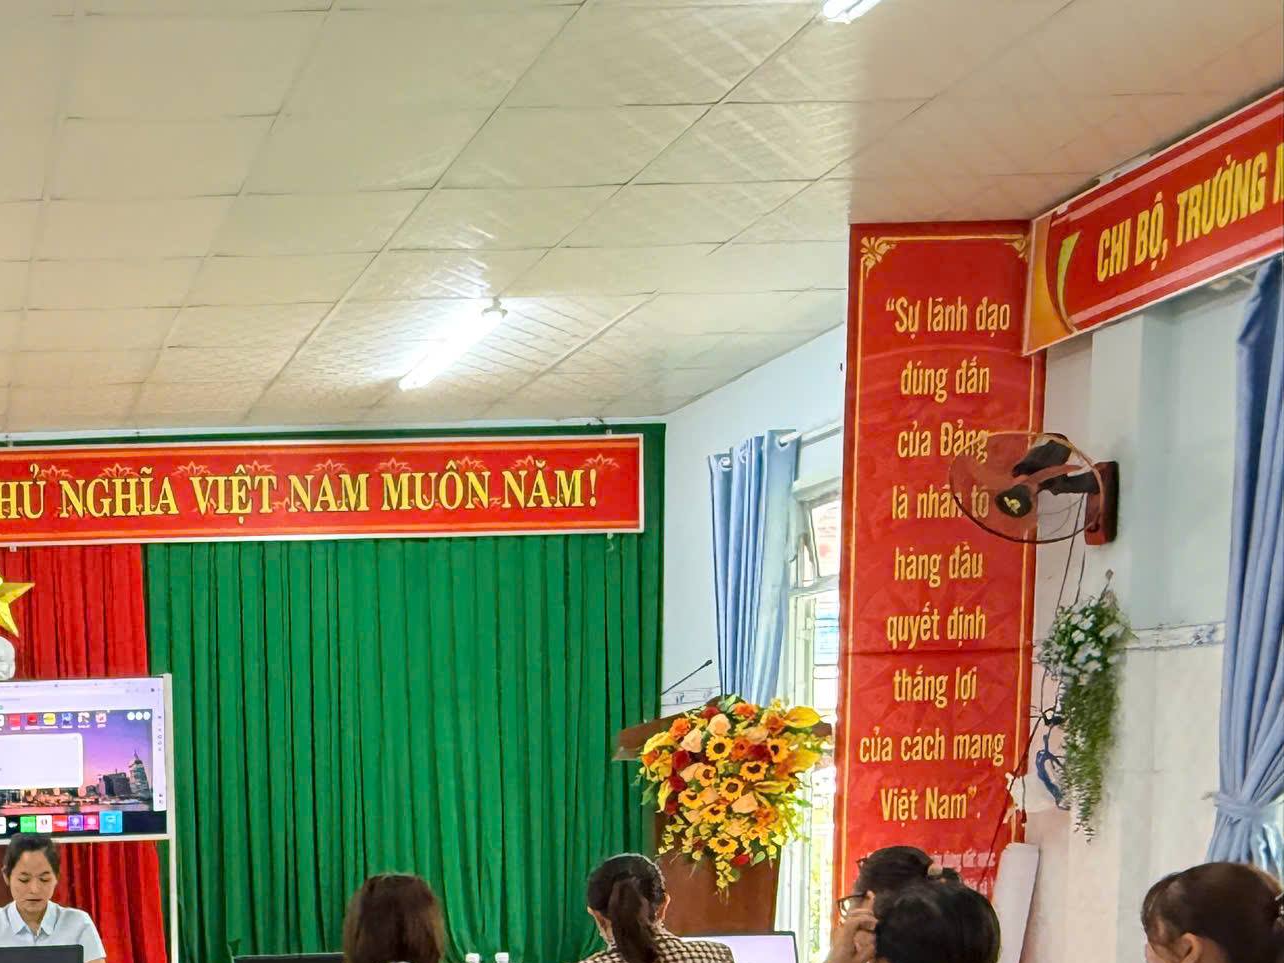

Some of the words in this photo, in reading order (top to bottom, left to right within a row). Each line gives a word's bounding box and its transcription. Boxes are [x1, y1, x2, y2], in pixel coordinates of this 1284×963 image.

[1097, 220, 1131, 282] CHI
[1134, 191, 1169, 272] BỘ,
[1175, 151, 1268, 248] TRƯỜNG
[927, 296, 968, 332] lãnh
[975, 296, 1010, 338] đạo
[900, 360, 948, 403] đúng
[955, 356, 990, 394] đắn
[897, 420, 932, 458] của
[940, 418, 989, 464] Đảng
[59, 466, 179, 518] NGHĨA
[188, 465, 278, 525] VIỆT
[287, 472, 370, 513] NAM
[380, 457, 492, 511] MUÔN
[500, 460, 598, 509] NĂM!
[892, 485, 909, 520] là
[916, 483, 963, 519] nhân
[894, 546, 942, 588] hàng
[948, 541, 983, 579] đầu
[886, 600, 941, 650] quyết
[947, 606, 986, 647] định
[893, 664, 949, 709] thắng
[954, 666, 977, 706] lợi
[859, 725, 893, 763] của
[900, 727, 946, 762] cách
[953, 733, 1006, 767] mạng
[880, 787, 919, 827] Việt
